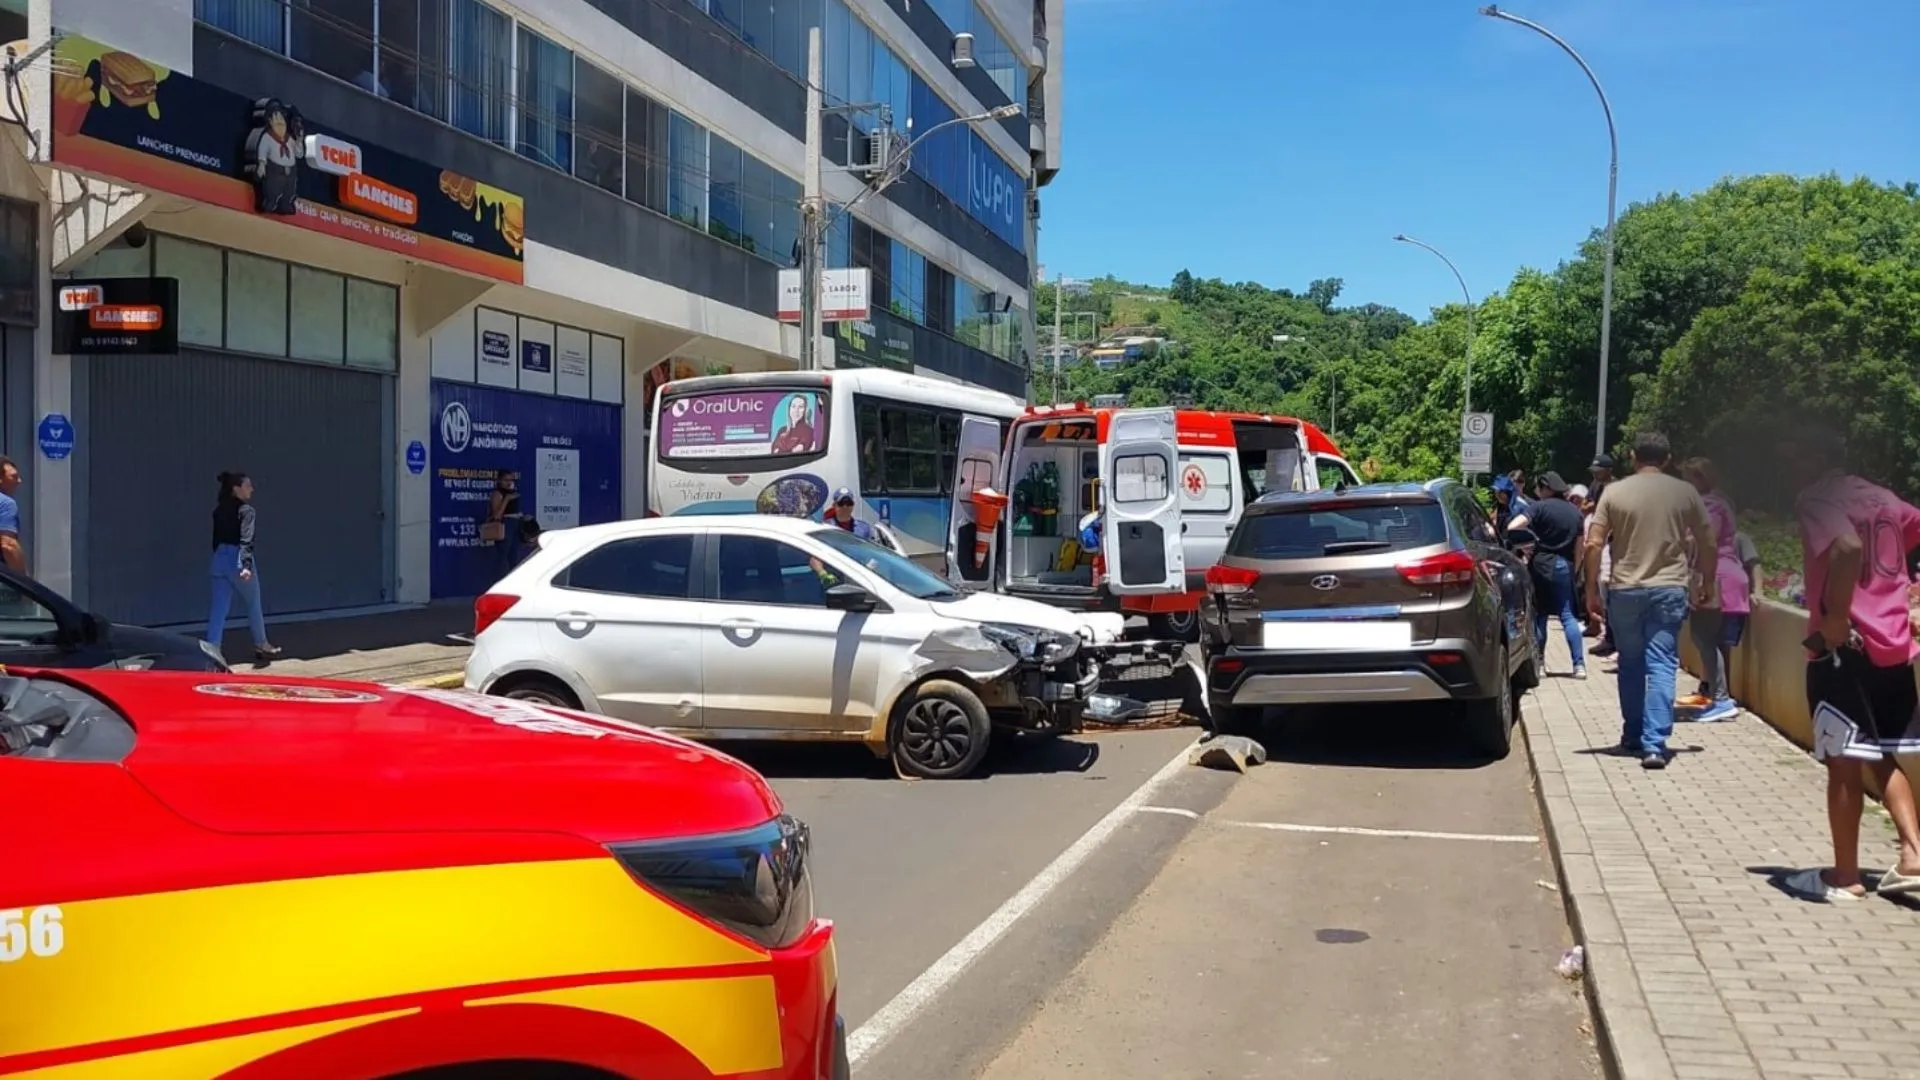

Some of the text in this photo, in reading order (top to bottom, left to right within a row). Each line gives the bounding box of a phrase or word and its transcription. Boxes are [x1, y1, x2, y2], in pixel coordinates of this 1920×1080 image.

[137, 134, 221, 168] LANCHES PRENSADOS
[320, 145, 357, 169] TCHÊ
[353, 180, 414, 215] LANCHES
[971, 153, 1014, 225] LUPO
[295, 201, 318, 217] Mais
[319, 211, 339, 225] que
[65, 287, 98, 304] TCHÊ
[95, 310, 158, 322] LANCHES
[693, 398, 764, 414] OralUnic
[443, 406, 468, 445] NA
[472, 421, 518, 435] NARCÓTICOS
[1472, 418, 1482, 431] E
[0, 905, 64, 962] 56
